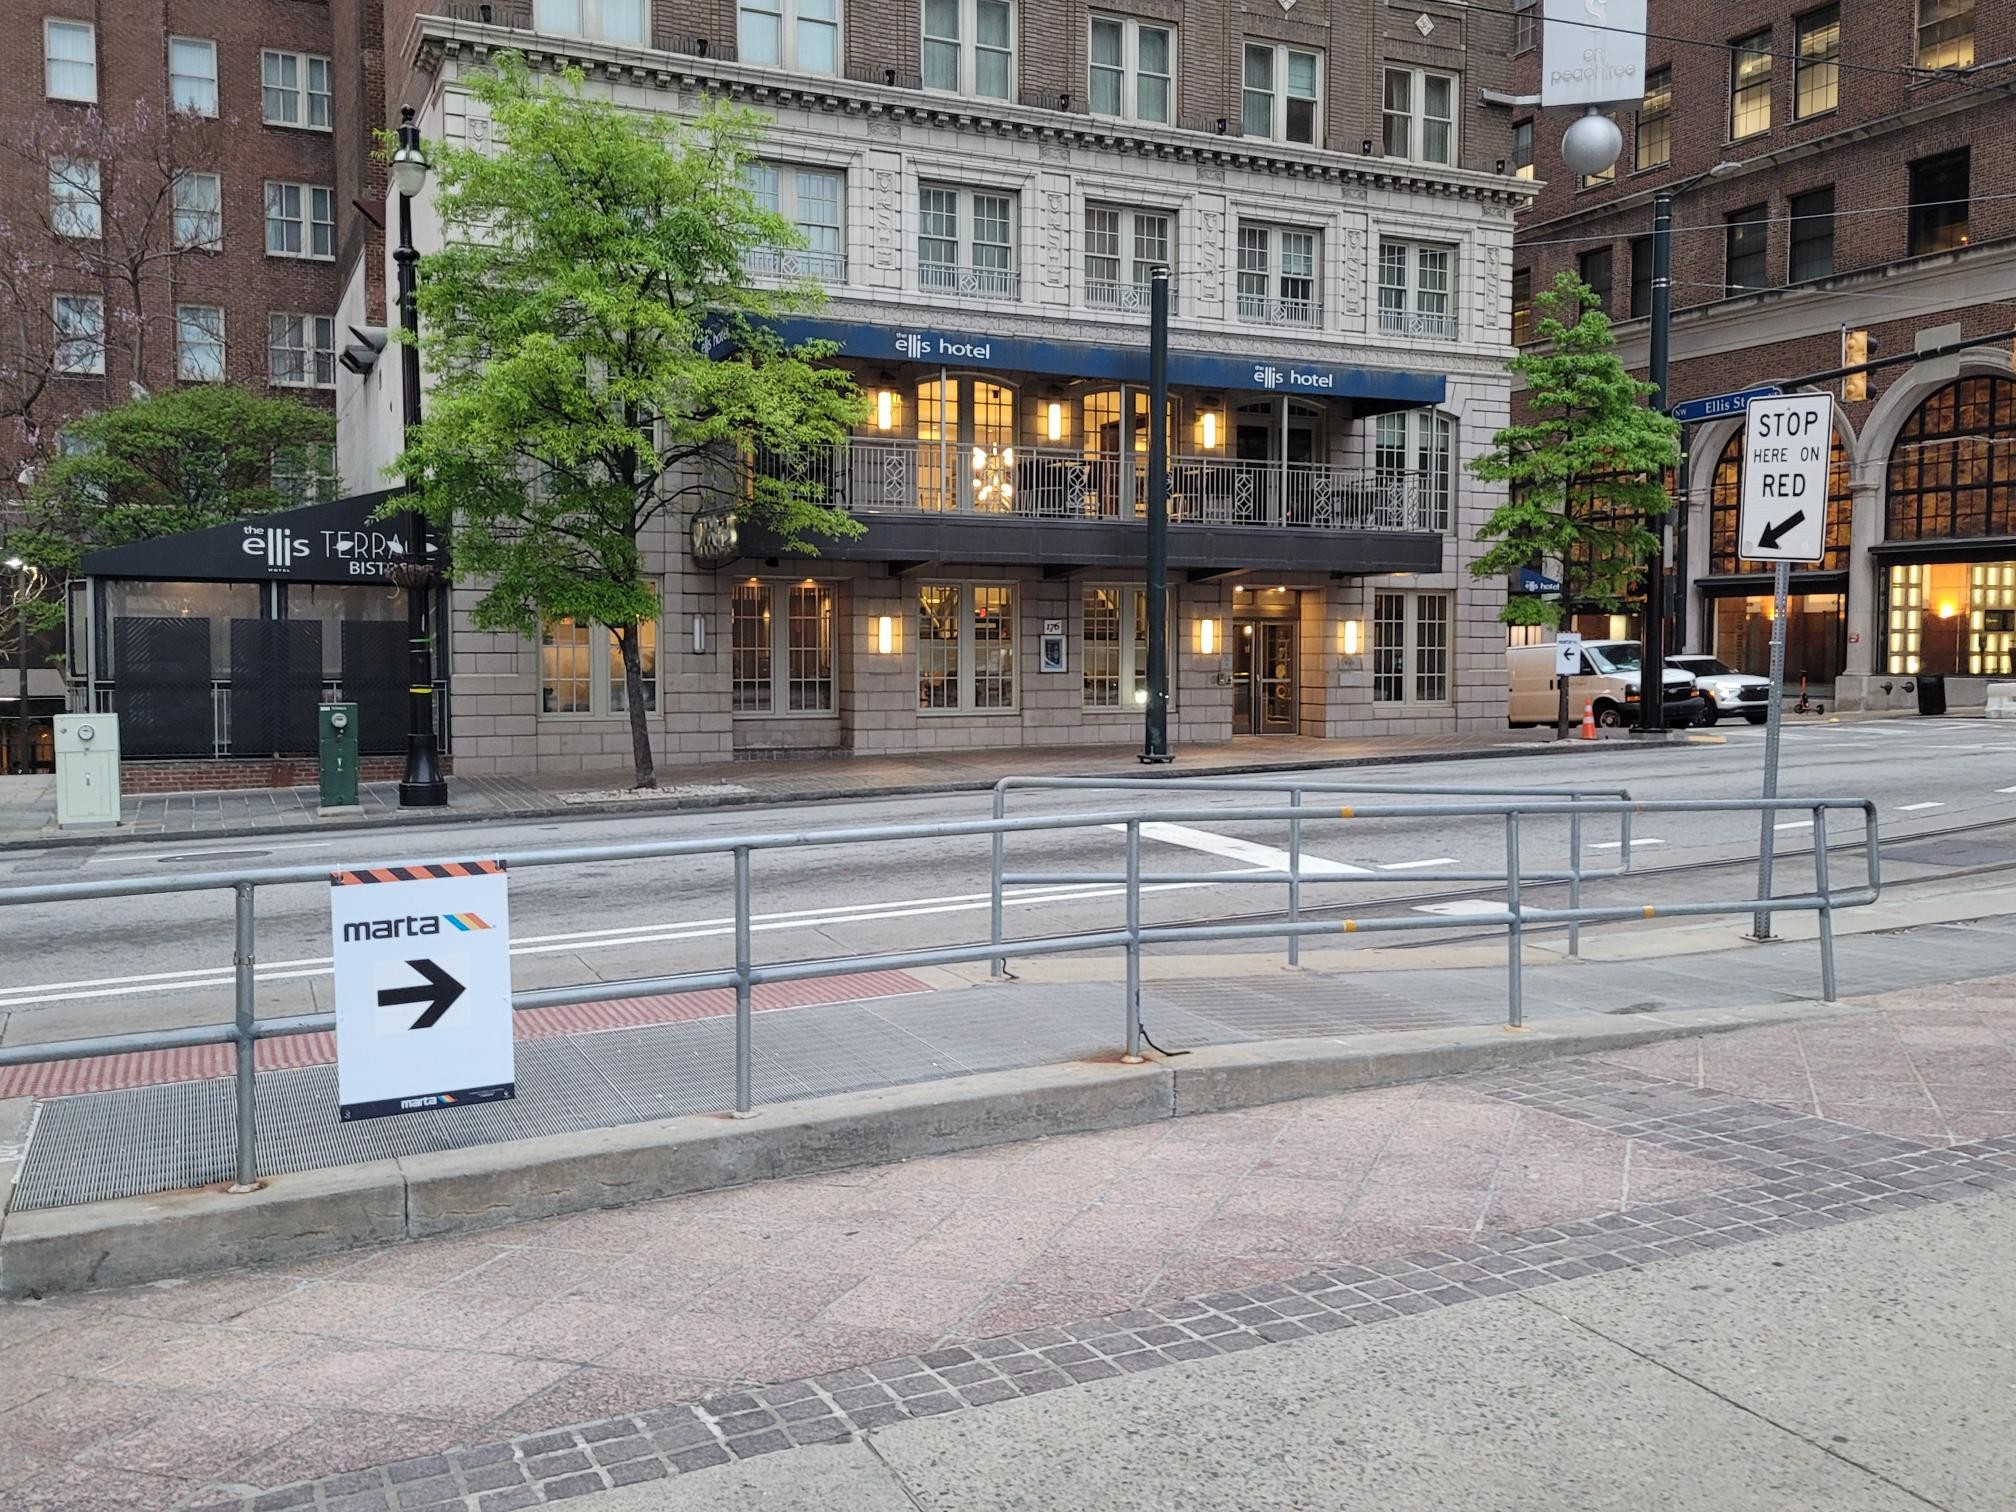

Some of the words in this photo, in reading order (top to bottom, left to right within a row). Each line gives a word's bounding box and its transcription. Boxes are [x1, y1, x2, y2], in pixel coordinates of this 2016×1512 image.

[1551, 64, 1636, 86] peachtree
[895, 334, 931, 359] ellis
[940, 338, 990, 359] hotel
[1253, 366, 1284, 389] ellis
[1290, 370, 1333, 388] hotel
[1675, 408, 1687, 417] NW
[1705, 400, 1730, 414] Ellis
[1733, 396, 1745, 409] St
[1759, 411, 1818, 437] STOP
[1754, 448, 1788, 463] HERE
[1800, 446, 1820, 461] ON
[1762, 473, 1806, 497] RED
[243, 525, 265, 535] the
[242, 528, 310, 566] ellis
[1540, 582, 1560, 591] hotel
[1046, 621, 1060, 632] 176
[344, 915, 440, 942] marta
[400, 1096, 438, 1109] marta
